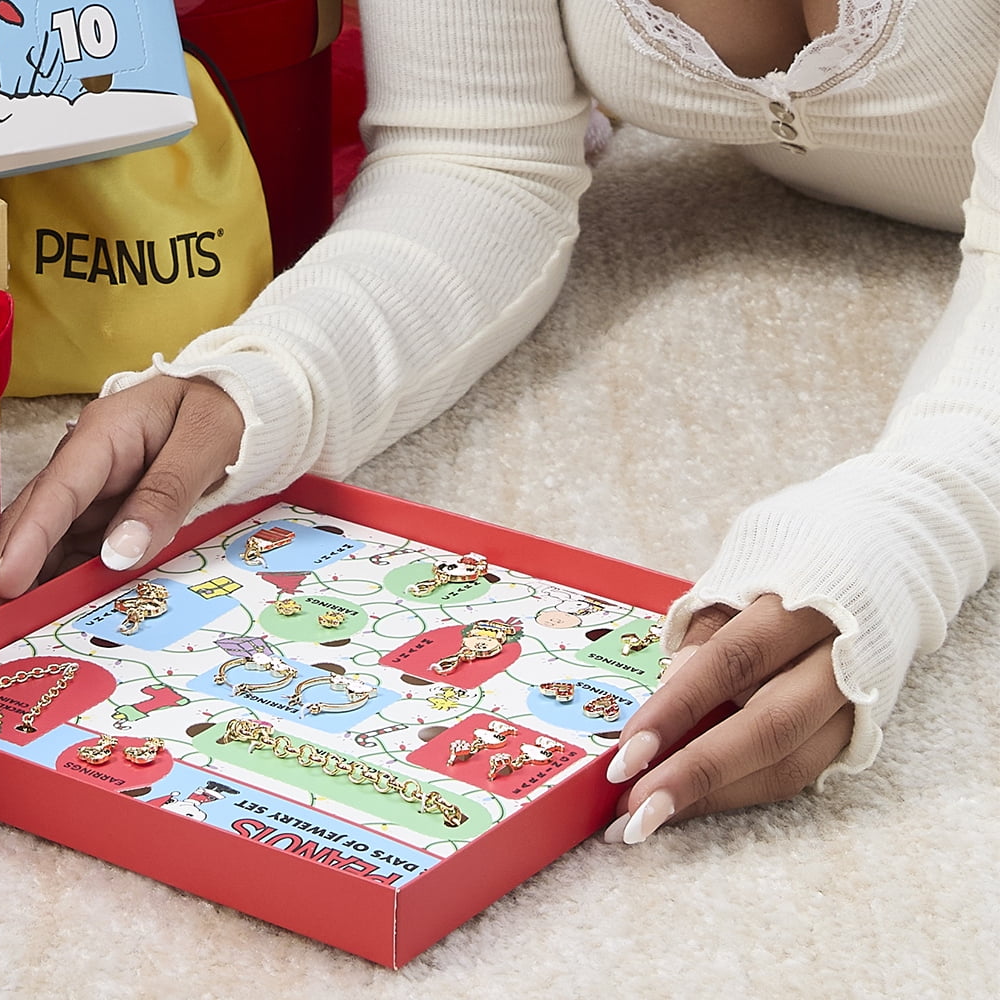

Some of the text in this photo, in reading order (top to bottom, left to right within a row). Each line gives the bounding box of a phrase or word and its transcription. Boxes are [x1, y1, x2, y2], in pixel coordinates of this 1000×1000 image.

[51, 4, 118, 63] 10
[304, 597, 359, 616] EARRINGS
[587, 653, 645, 675] EARRINGS
[63, 761, 126, 786] EARRINGS
[233, 799, 269, 815] SET
[267, 811, 349, 844] JEWELRY
[341, 839, 370, 852] OF
[369, 850, 420, 872] DAYS
